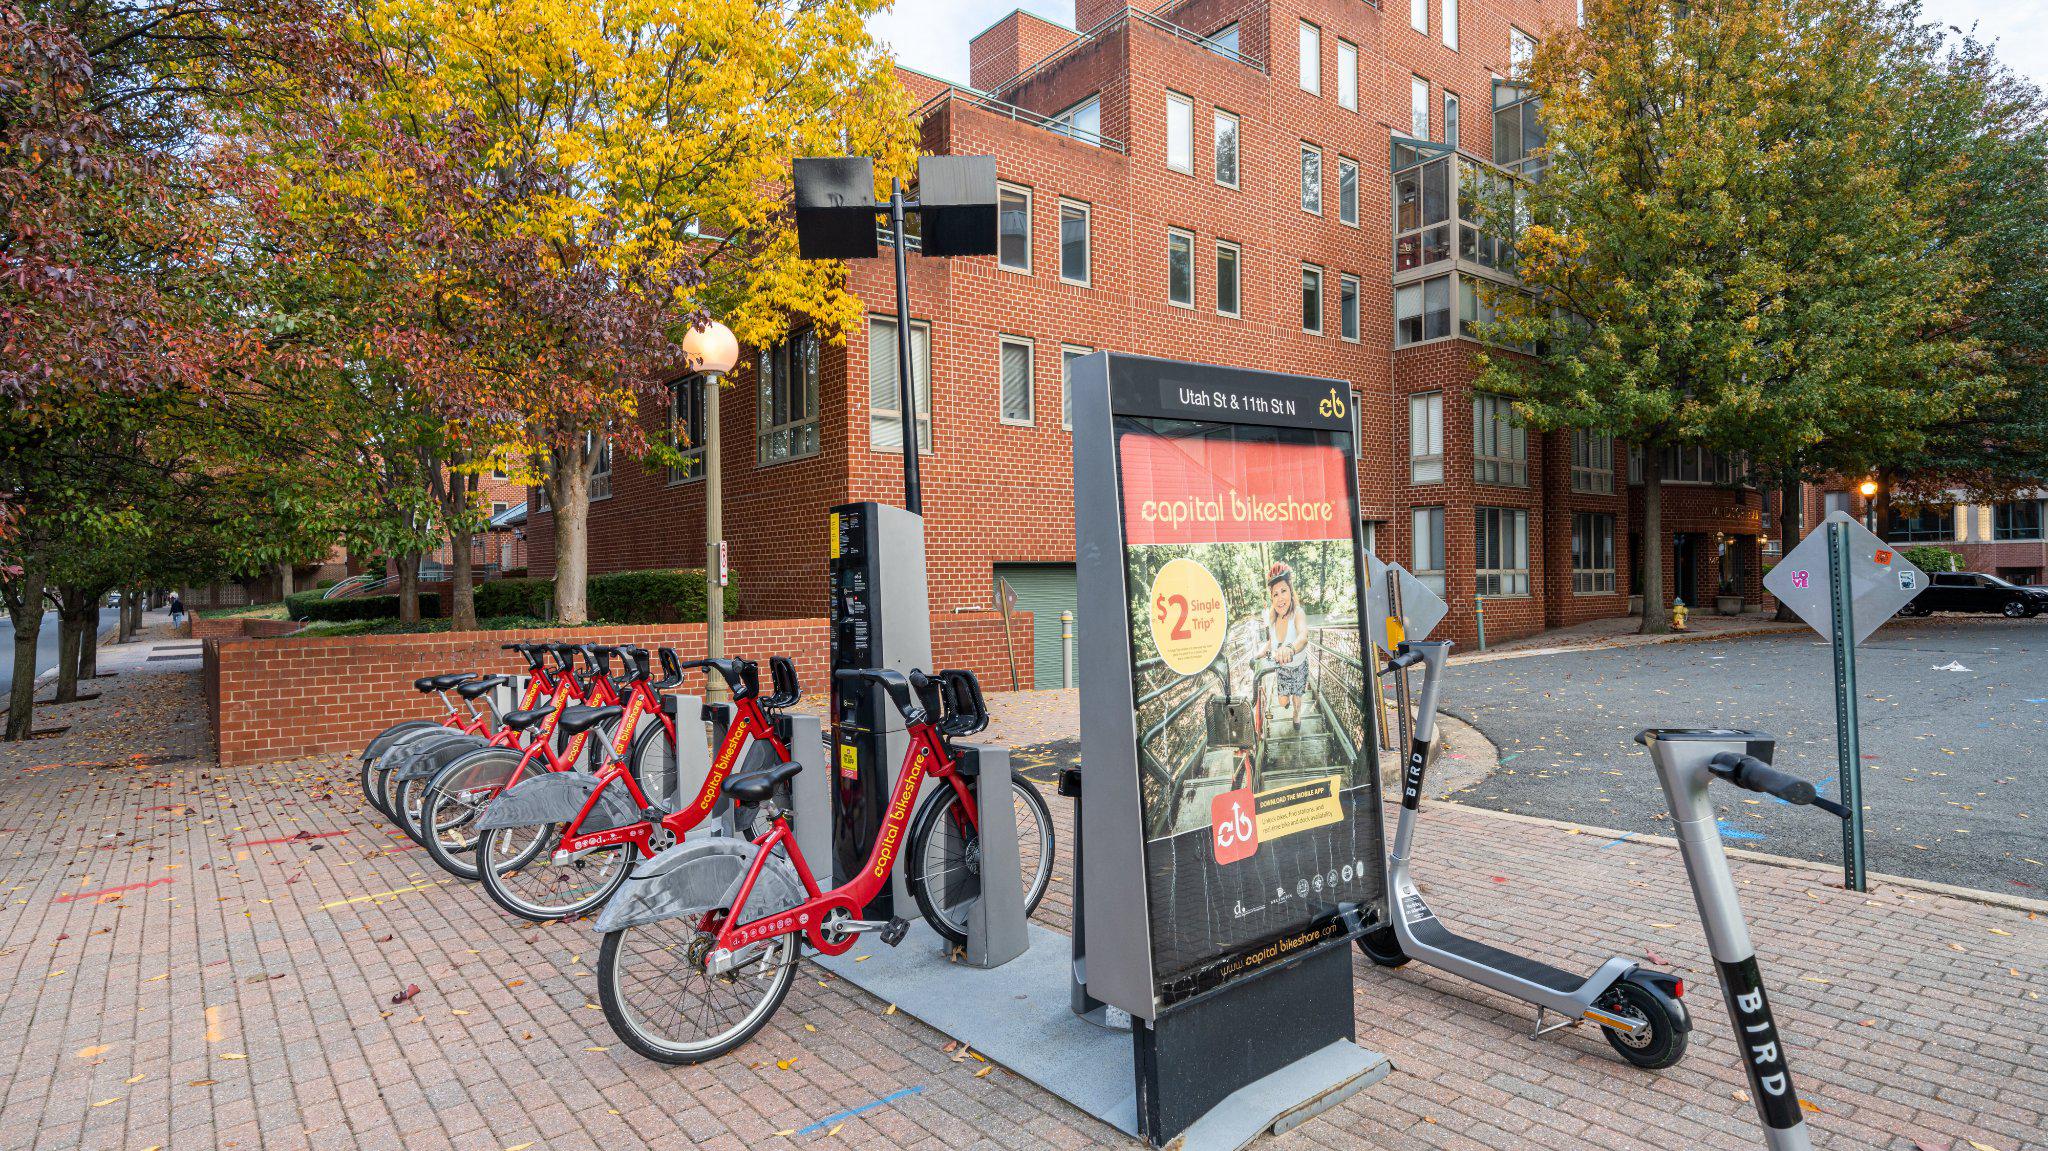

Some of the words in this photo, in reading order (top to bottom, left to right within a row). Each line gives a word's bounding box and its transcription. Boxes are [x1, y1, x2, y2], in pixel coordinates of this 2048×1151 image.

[1179, 388, 1210, 407] Utah
[1213, 391, 1228, 409] St
[1230, 394, 1240, 410] &
[1242, 396, 1269, 412] 11th
[1271, 398, 1284, 415] St
[1286, 400, 1296, 416] N
[1141, 493, 1225, 530] capital
[1229, 488, 1333, 522] bikeshare
[1156, 593, 1192, 641] $2
[1191, 598, 1221, 613] Single
[618, 700, 643, 741] bikeshare
[701, 771, 723, 810] capital
[716, 721, 747, 770] bikeshare
[1405, 752, 1423, 797] BIRD
[874, 823, 900, 878] capital
[890, 754, 925, 821] bikeshare
[1260, 796, 1287, 809] DOWNLOAD
[1286, 793, 1296, 801] THE
[1737, 986, 1787, 1097] BIRD
